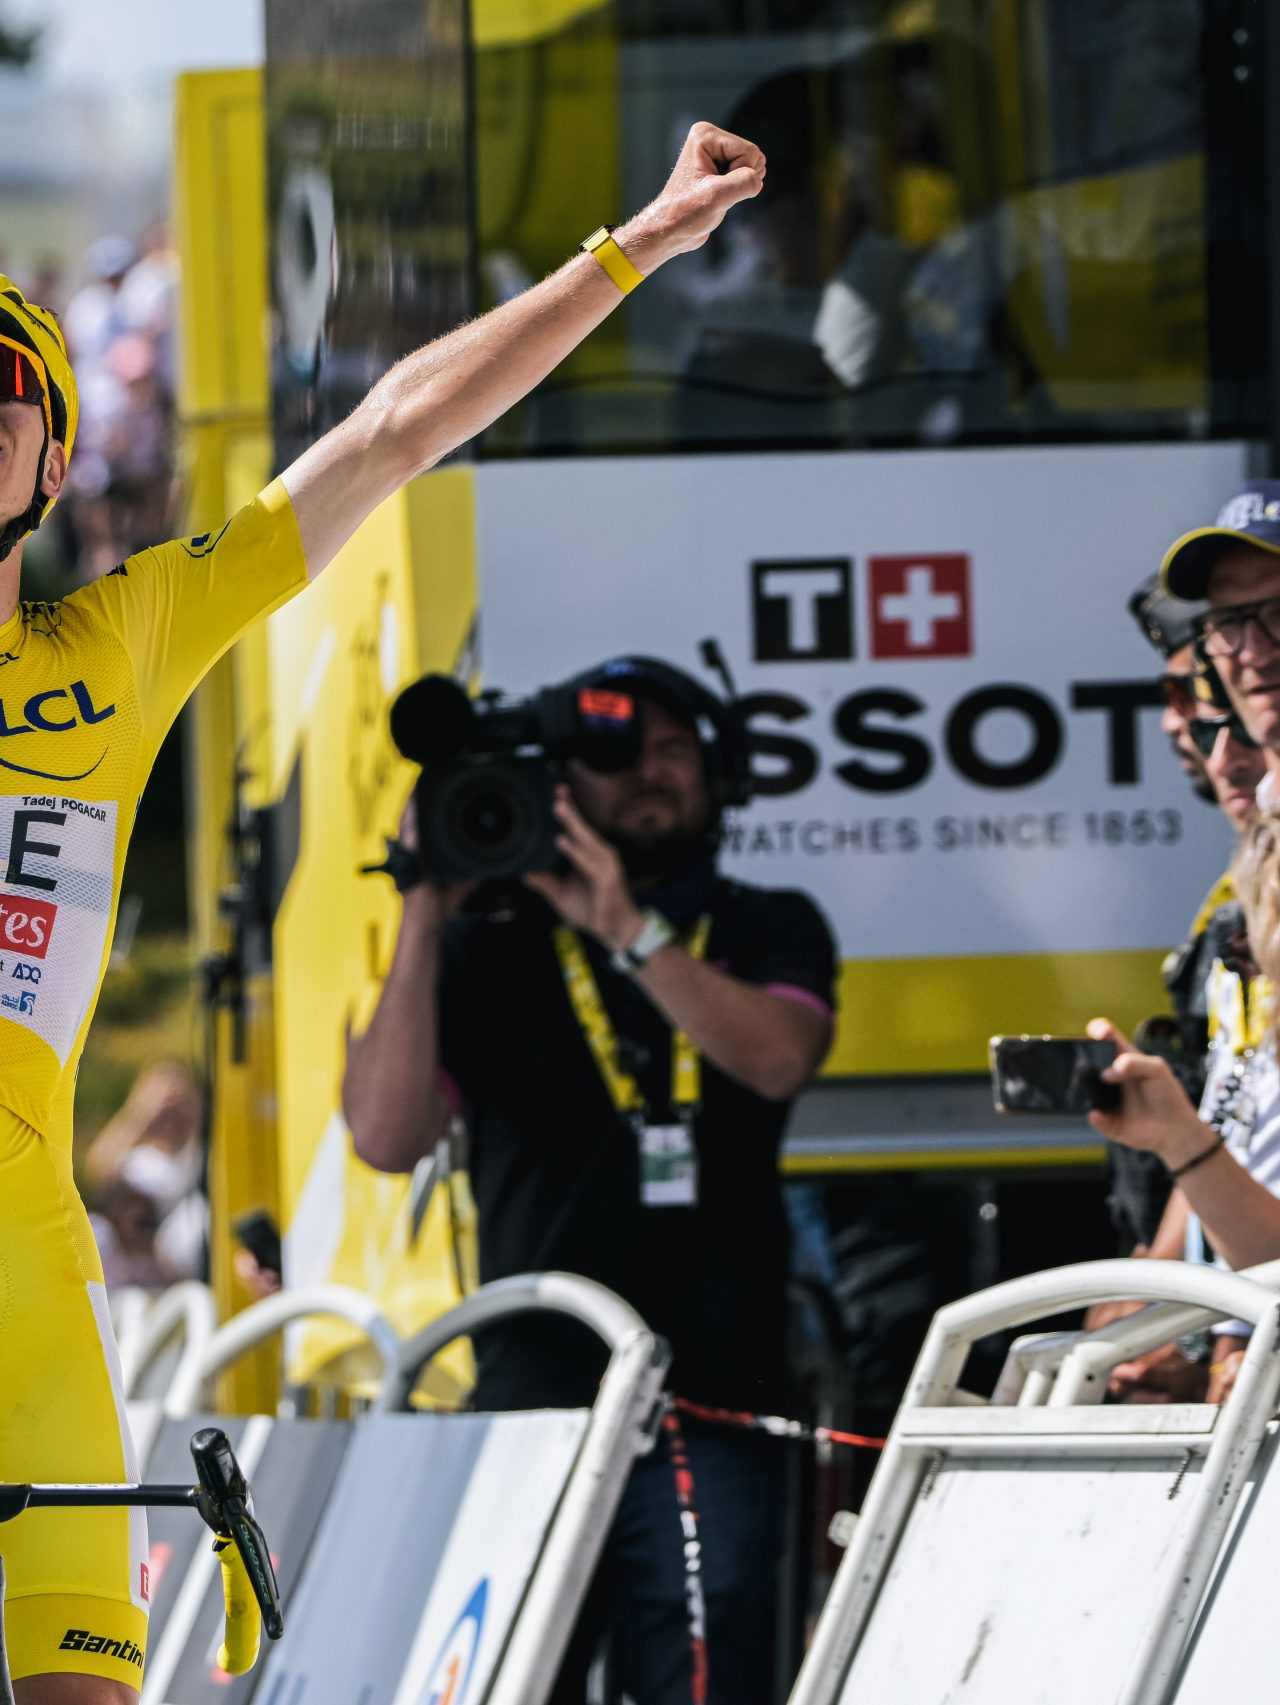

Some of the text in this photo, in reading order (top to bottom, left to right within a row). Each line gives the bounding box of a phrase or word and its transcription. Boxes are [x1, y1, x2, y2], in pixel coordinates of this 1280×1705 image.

[738, 681, 1167, 796] SSOT
[22, 796, 106, 822] Tadej POGACAR
[933, 812, 1067, 852] SINCE
[12, 963, 41, 984] ADQ
